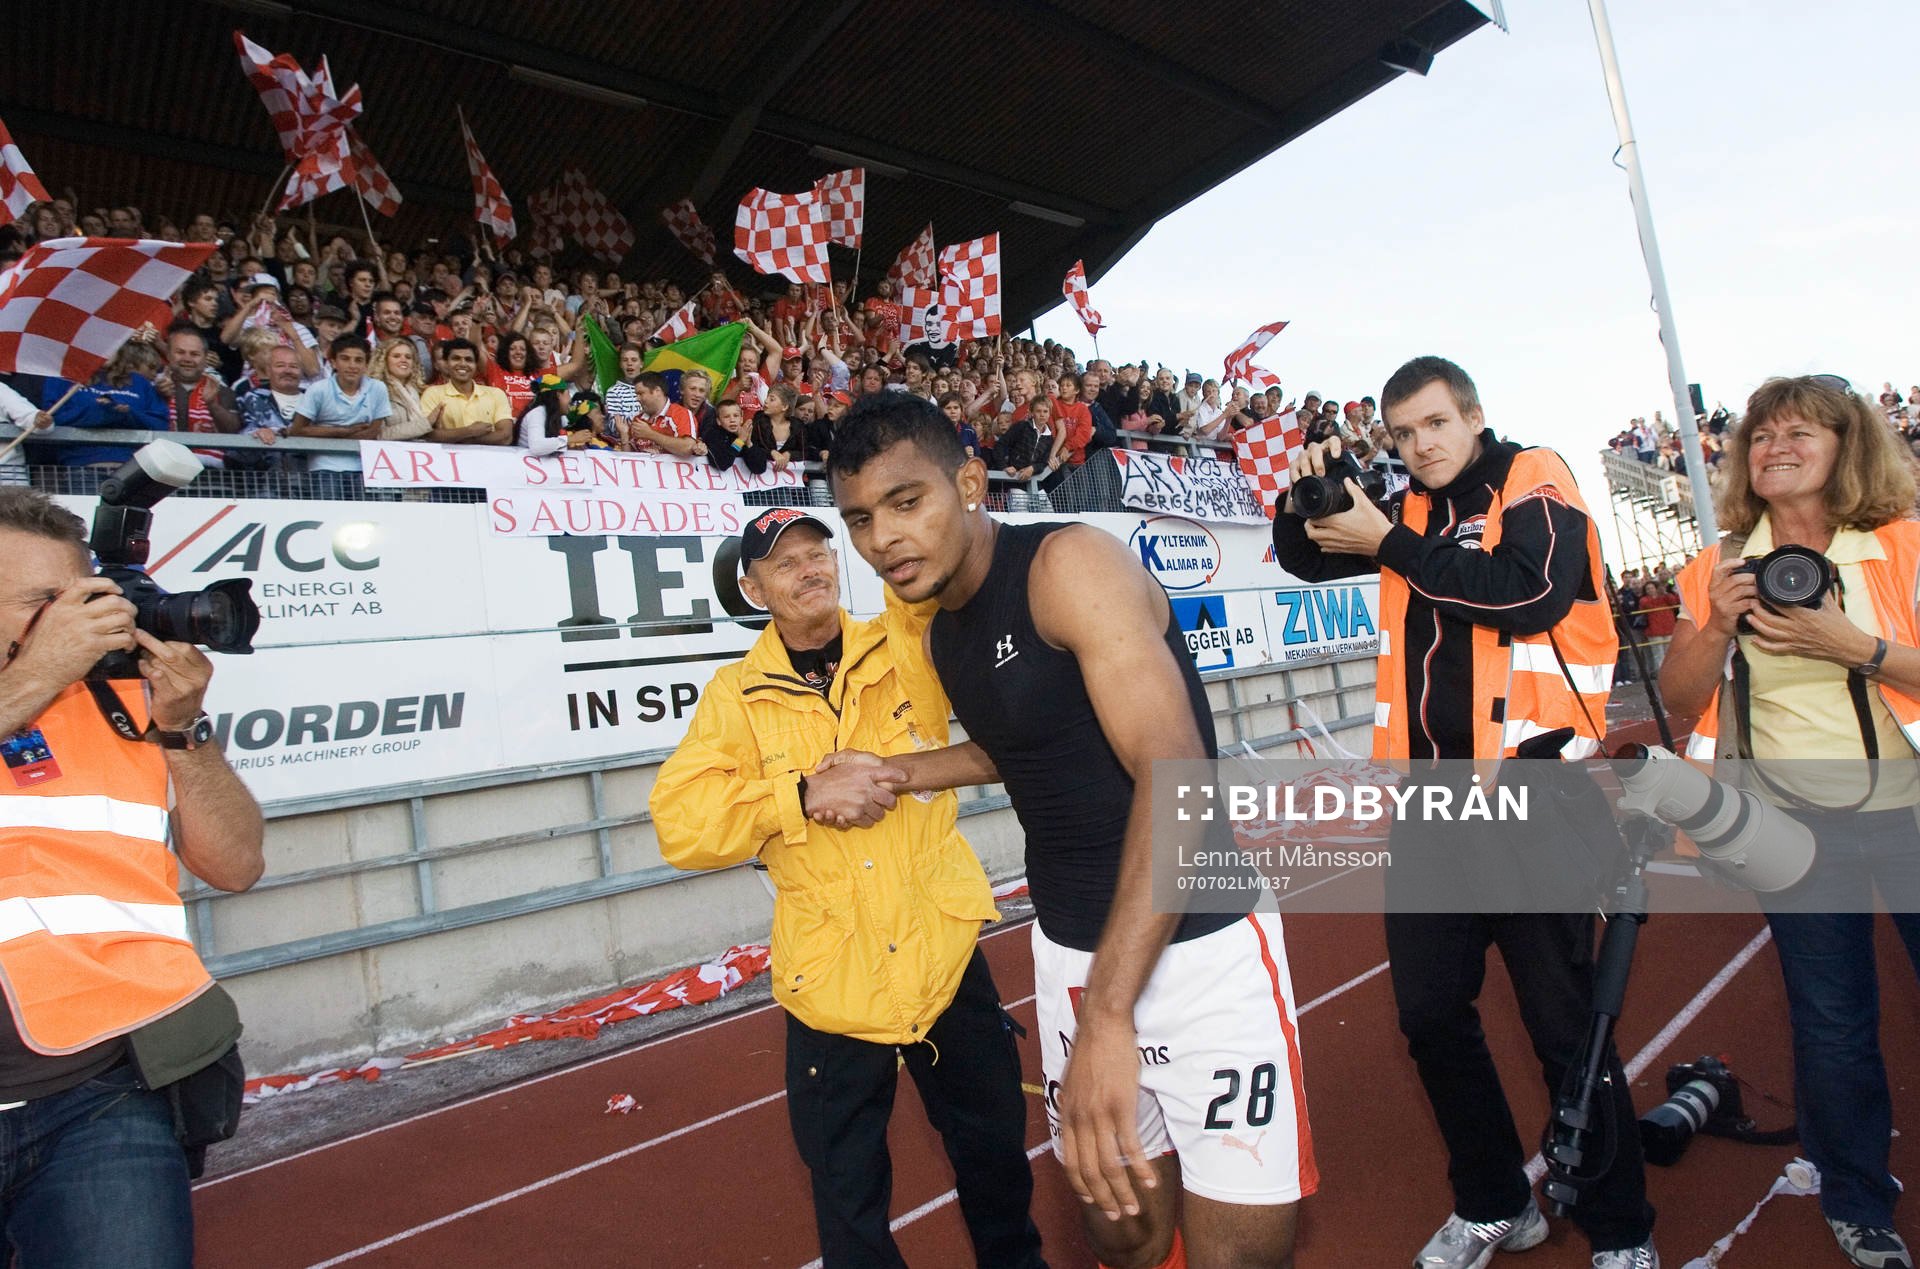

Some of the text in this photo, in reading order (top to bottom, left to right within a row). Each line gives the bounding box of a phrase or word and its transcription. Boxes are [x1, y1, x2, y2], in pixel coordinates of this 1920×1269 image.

[369, 448, 464, 483] ARI
[492, 498, 740, 533] SAUDADES
[192, 520, 380, 573] ACC
[1201, 558, 1214, 570] AB
[263, 581, 377, 597] ENERGI &
[351, 601, 383, 615] AB
[1275, 586, 1376, 646] ZIWA
[1236, 627, 1254, 646] AB
[1285, 646, 1321, 661] MEKANISK
[1322, 640, 1368, 656] TILLVERKNING
[567, 689, 620, 731] IN
[280, 745, 367, 766] MACHINERY
[372, 738, 422, 755] GROUP
[1204, 1061, 1279, 1130] 28
